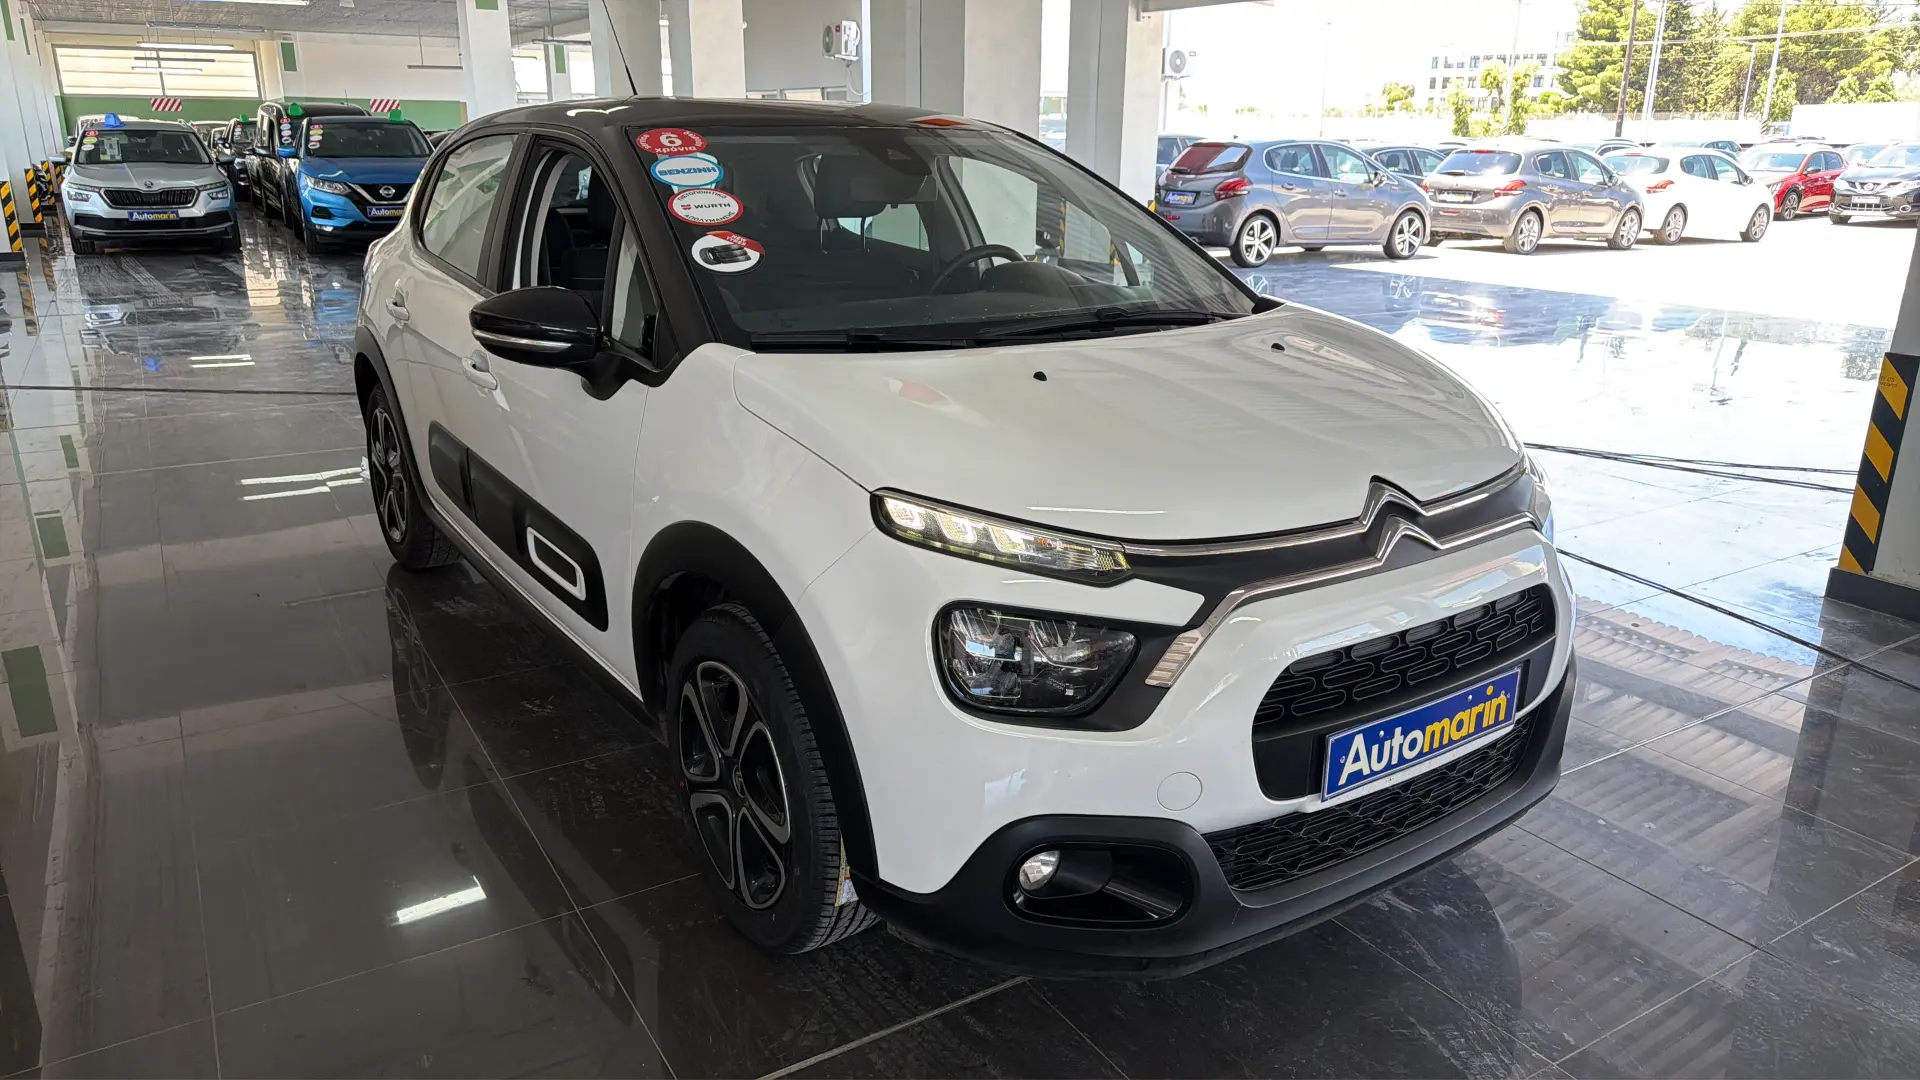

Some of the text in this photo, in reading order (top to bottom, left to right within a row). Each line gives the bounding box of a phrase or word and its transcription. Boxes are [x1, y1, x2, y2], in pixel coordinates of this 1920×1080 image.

[660, 134, 682, 147] 6
[133, 211, 176, 220] Automarin
[371, 208, 403, 216] Automar
[1338, 685, 1507, 786] Automarin
